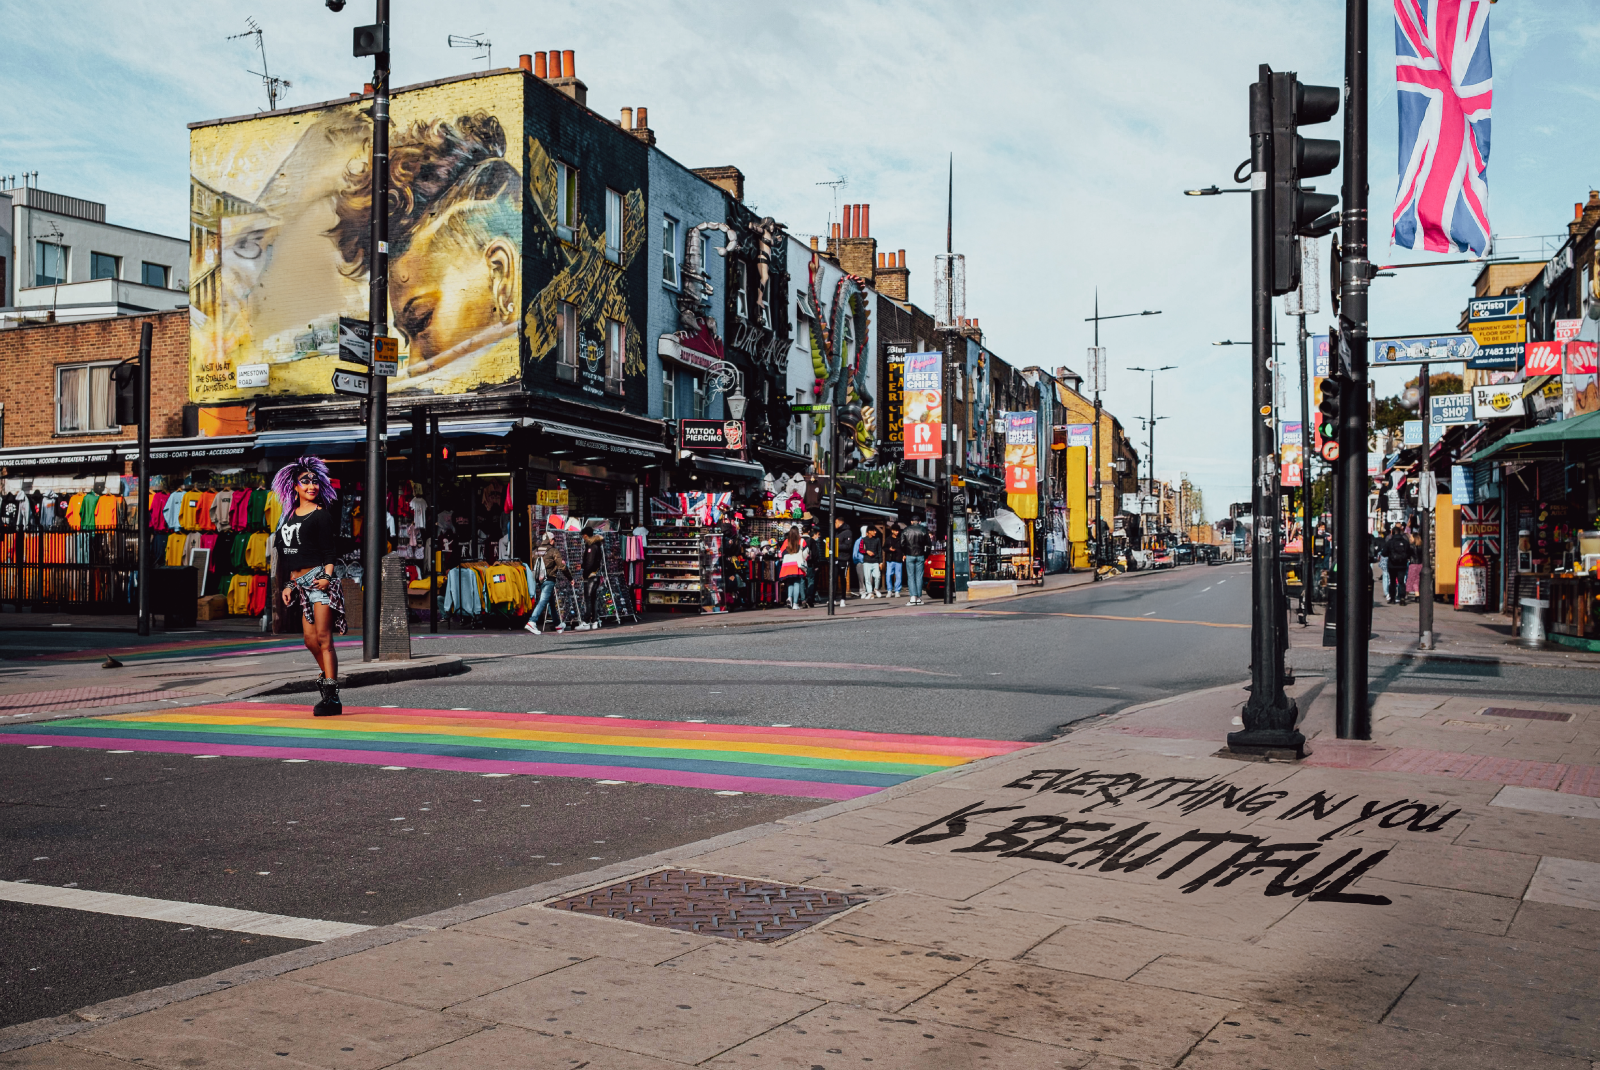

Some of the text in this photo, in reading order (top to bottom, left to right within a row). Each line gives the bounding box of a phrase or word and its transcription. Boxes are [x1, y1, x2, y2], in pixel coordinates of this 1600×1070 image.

[1473, 301, 1504, 311] Christo
[354, 327, 370, 337] CCTV
[1558, 329, 1571, 337] TO
[887, 346, 906, 354] Blue
[1485, 347, 1504, 356] 7482
[1505, 346, 1525, 355] 1203
[1527, 346, 1560, 372] illy
[202, 363, 214, 372] VISIT
[224, 361, 231, 370] AT
[196, 372, 236, 383] THE STABLES OR
[238, 369, 268, 377] JAMESTOWN
[906, 373, 939, 381] FISH &
[238, 378, 253, 386] ROAD
[906, 380, 939, 389] CHIPS
[888, 363, 898, 442] PIERCING
[1478, 391, 1524, 407] Martens
[1442, 406, 1469, 417] SHOP
[685, 434, 722, 442] PIERCING
[208, 448, 245, 456] ACCESSORIES
[912, 444, 917, 452] 1
[918, 443, 933, 452] MIN
[38, 457, 58, 465] HOODIES
[60, 455, 84, 463] SWEATERS
[1463, 524, 1499, 536] LONDON
[1002, 768, 1462, 842] EVERYTHING IN YOU
[883, 800, 1393, 906] IS BEAUTIFUL
